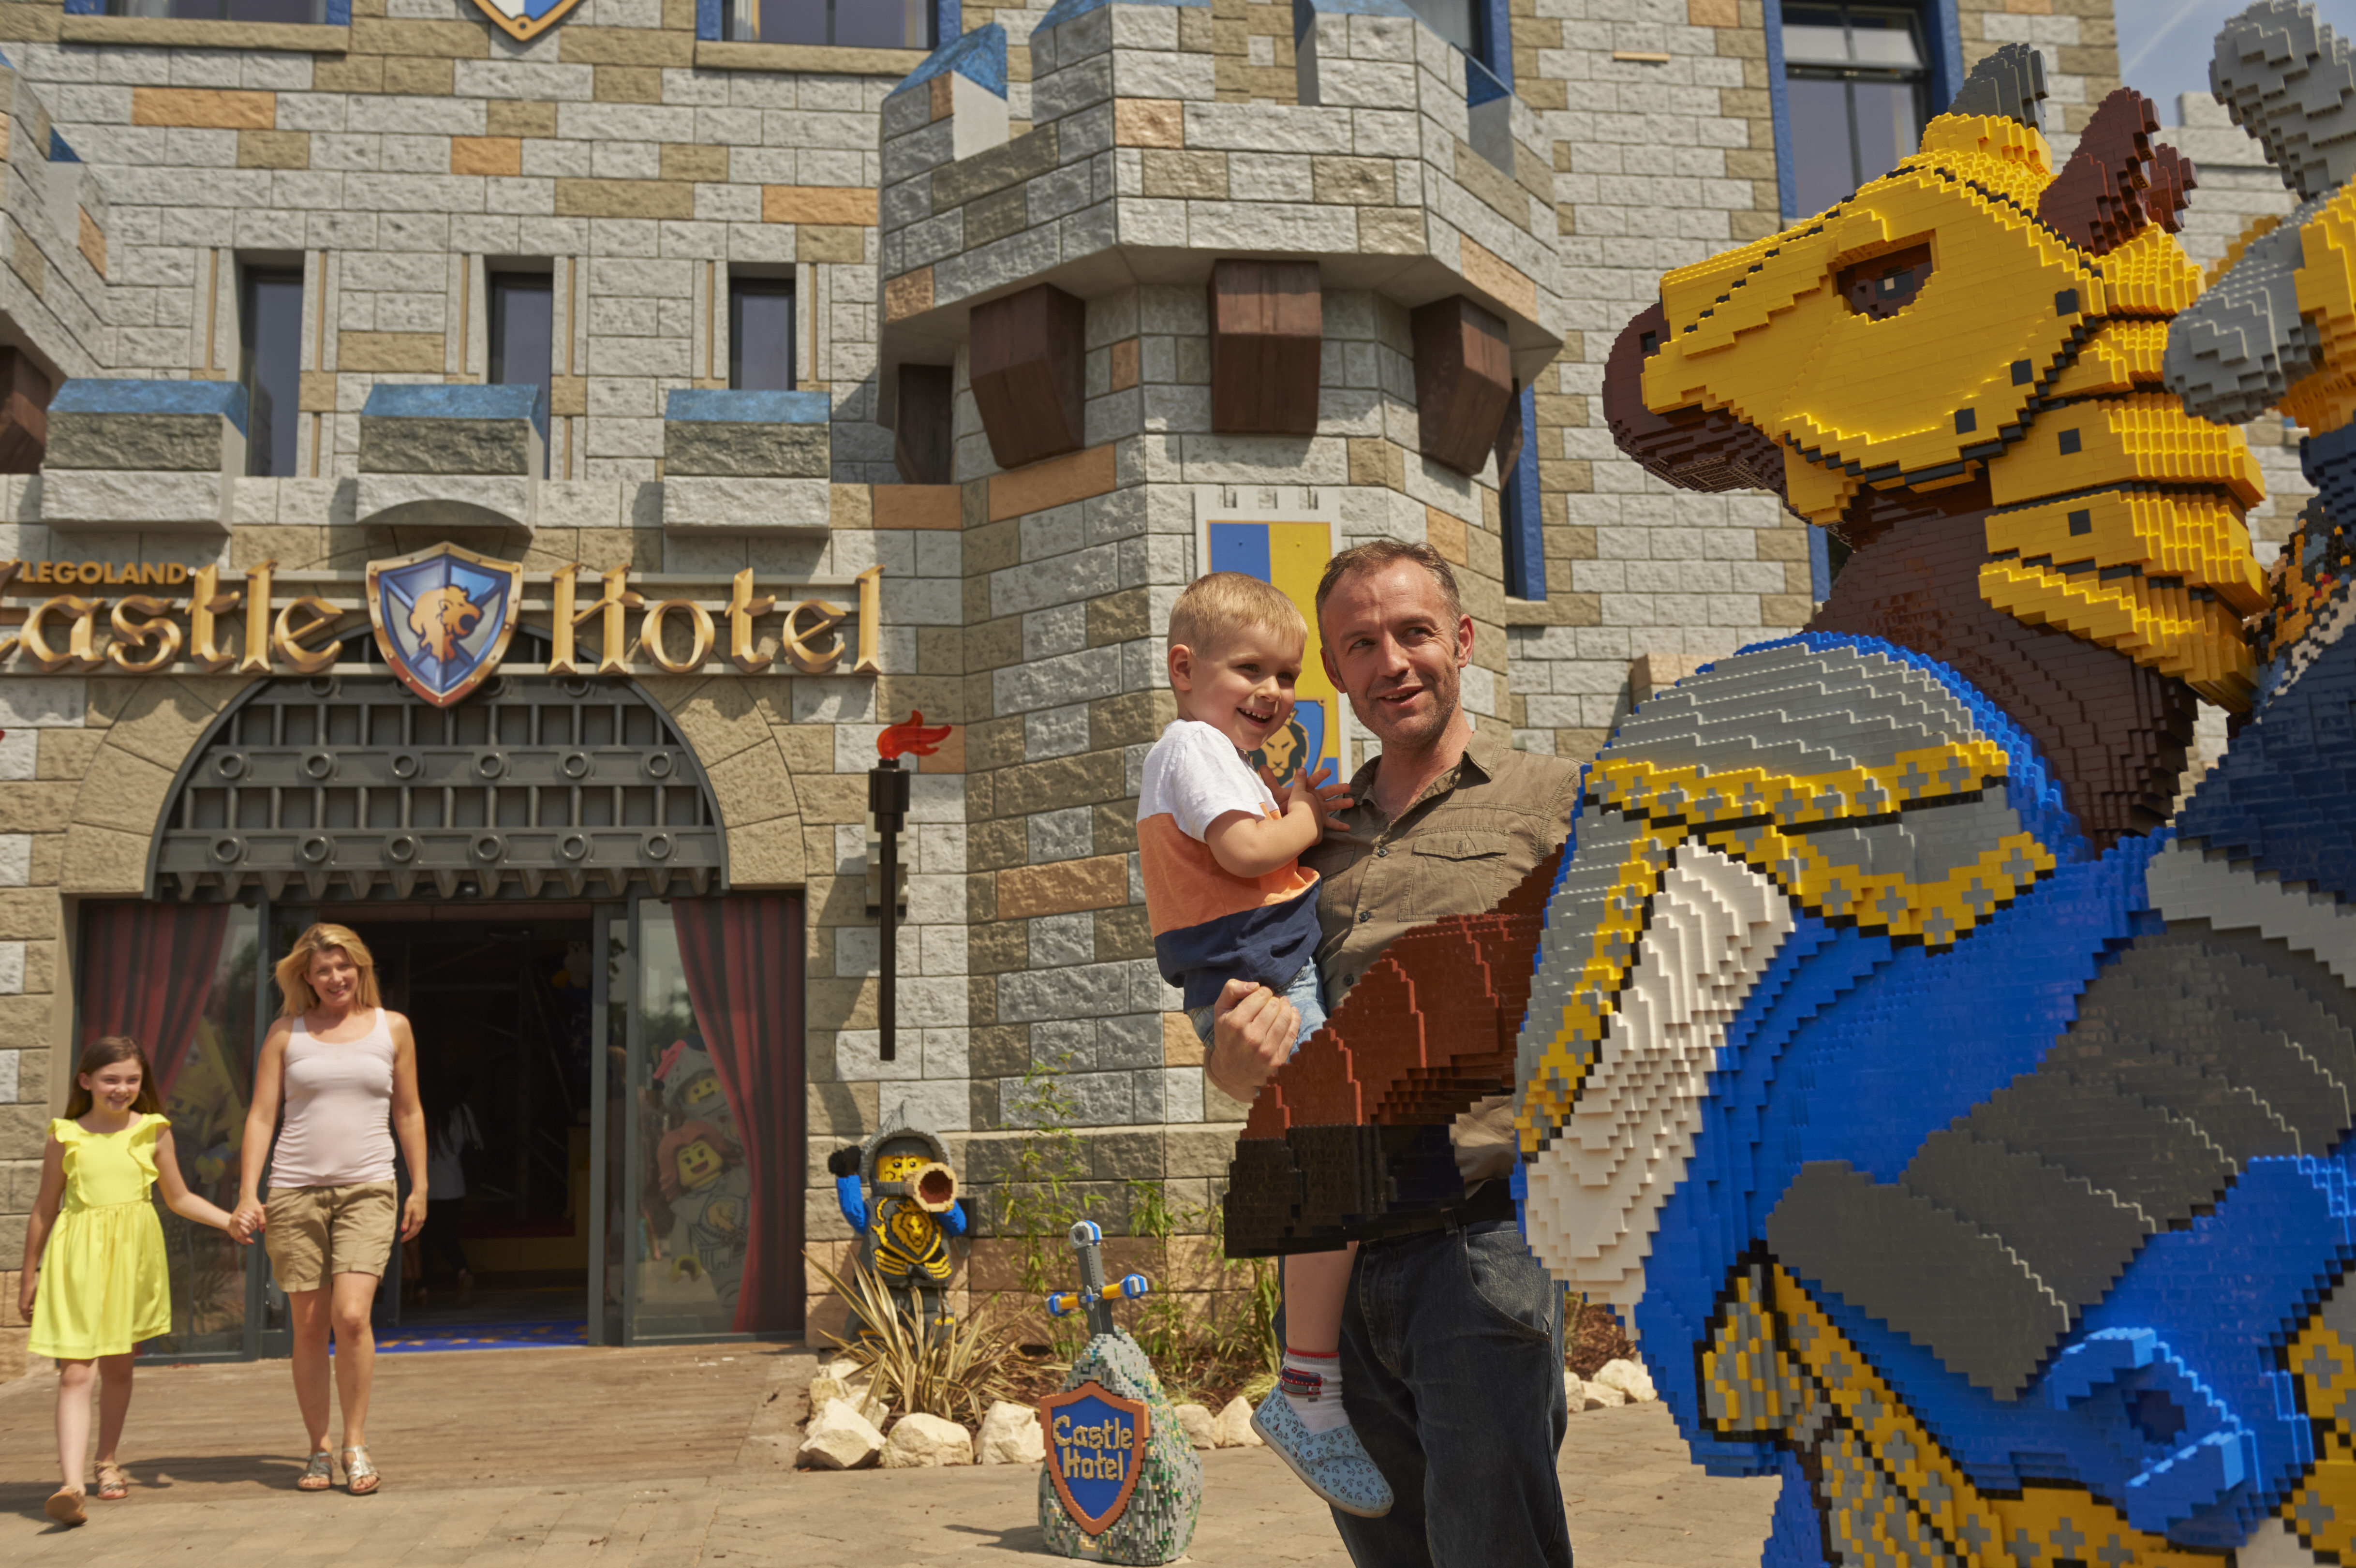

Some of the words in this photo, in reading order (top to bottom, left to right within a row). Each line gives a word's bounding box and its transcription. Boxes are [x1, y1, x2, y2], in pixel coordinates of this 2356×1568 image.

[22, 561, 188, 585] LEGOLAND
[0, 558, 344, 673] astle
[548, 562, 886, 674] Hotel
[1052, 1415, 1133, 1449] Castle
[1063, 1447, 1124, 1481] Hotel
